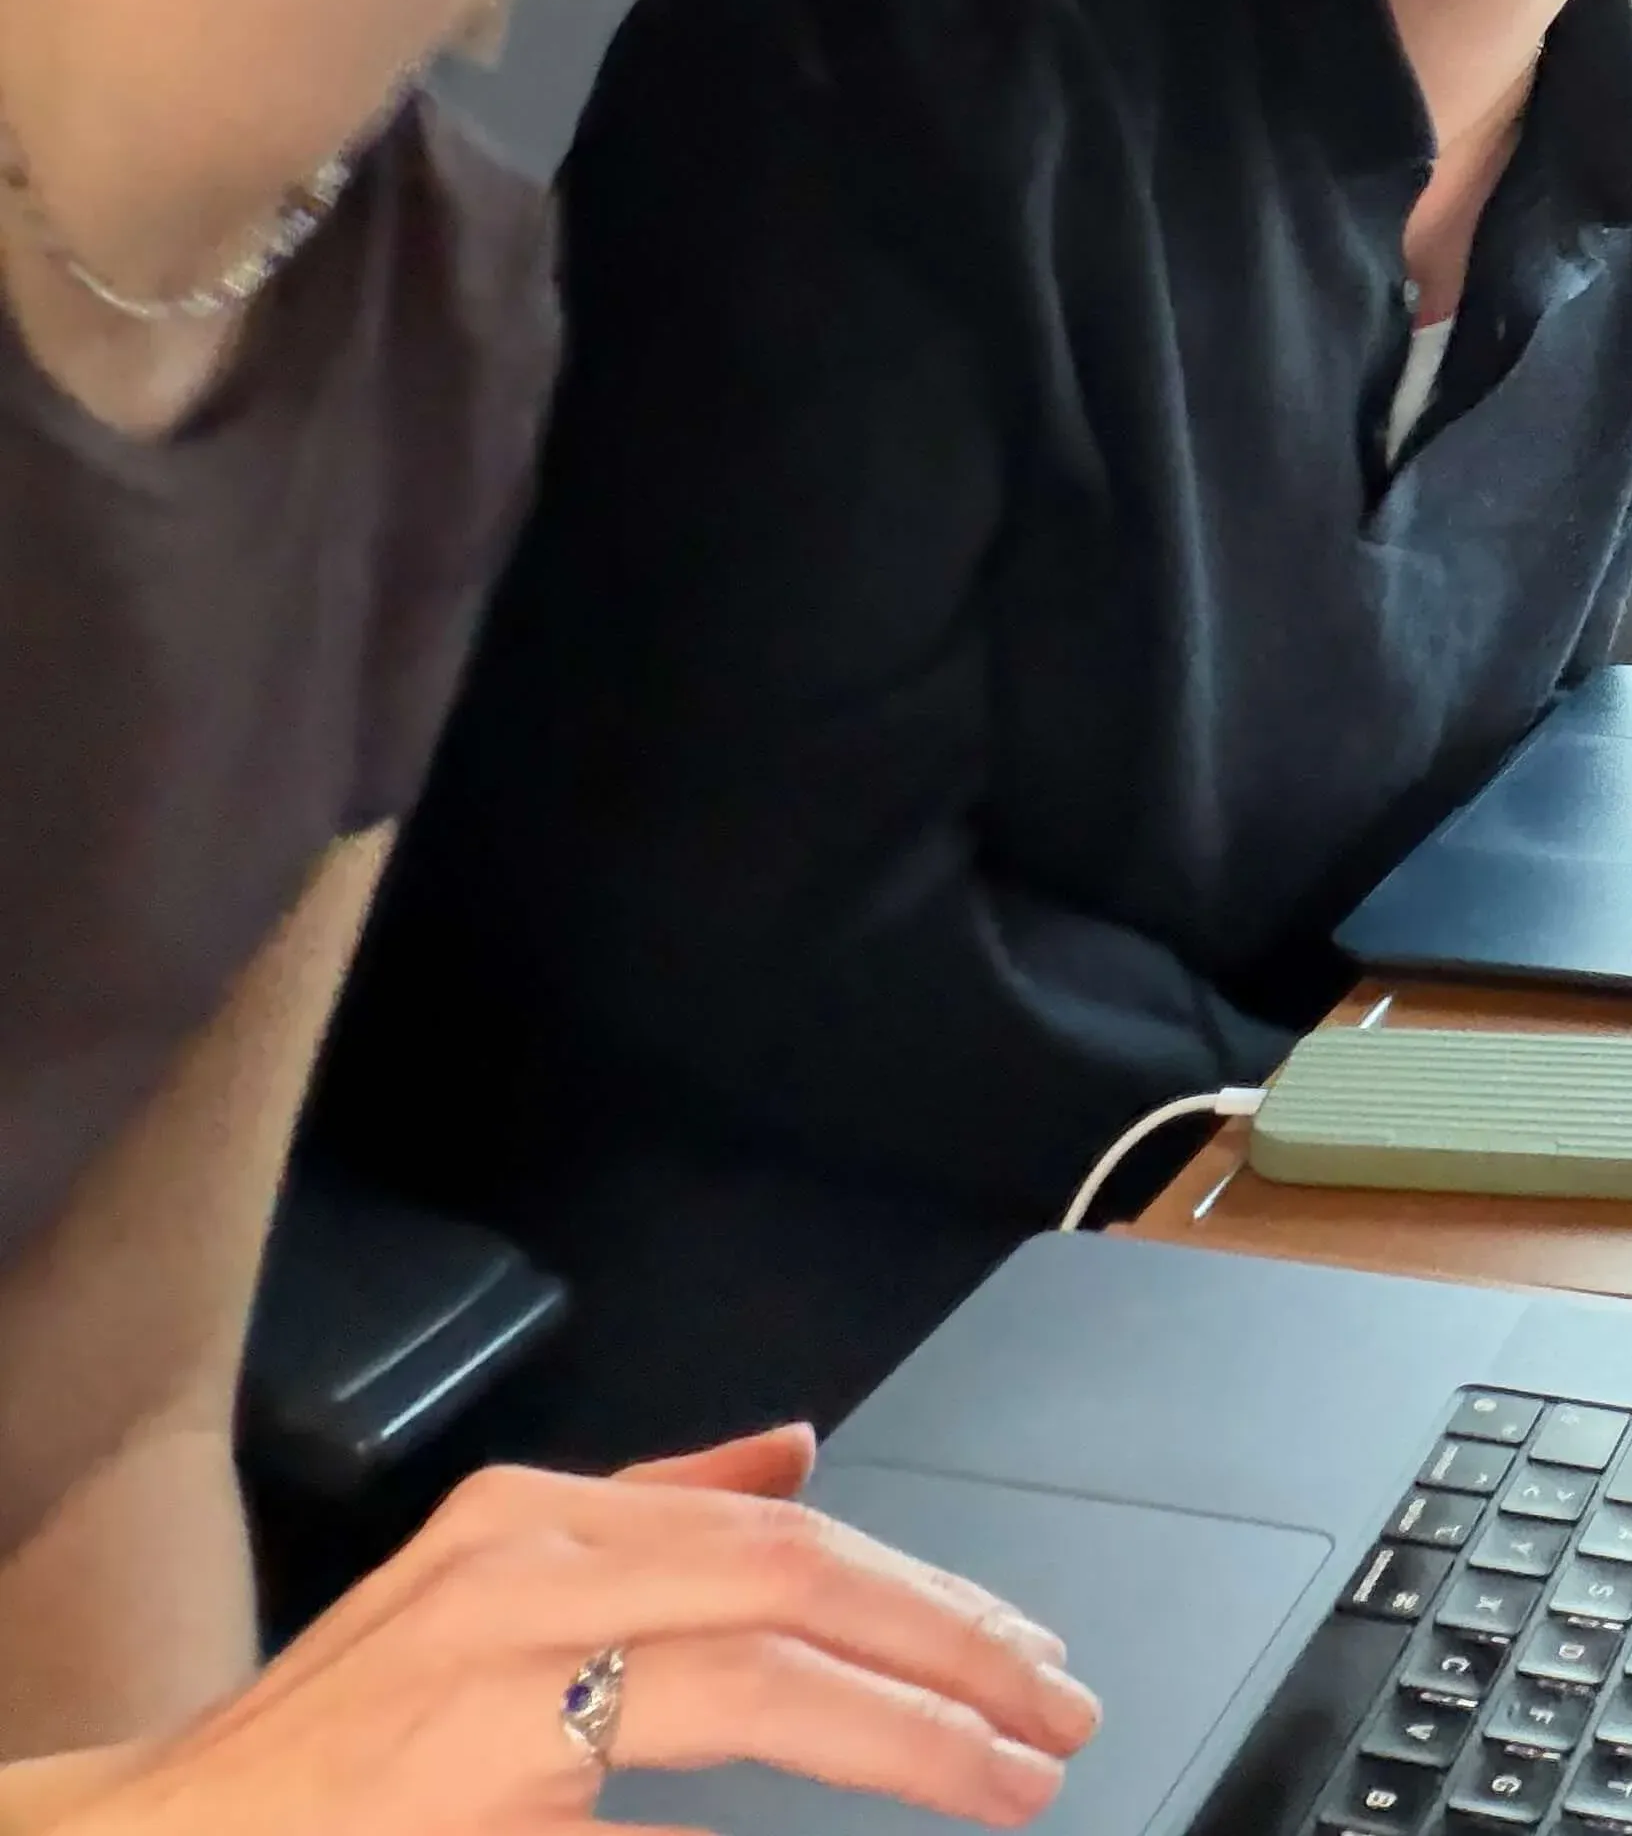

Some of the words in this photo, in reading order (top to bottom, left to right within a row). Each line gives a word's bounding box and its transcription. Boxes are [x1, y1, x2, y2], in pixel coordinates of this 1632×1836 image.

[1509, 1542, 1534, 1556] Y
[1587, 1582, 1615, 1599] S
[1475, 1596, 1504, 1614] X
[1558, 1644, 1586, 1660] D
[1440, 1656, 1472, 1675] C
[1528, 1708, 1556, 1724] F
[1404, 1724, 1436, 1741] V
[1490, 1775, 1523, 1797] G
[1364, 1789, 1399, 1810] B
